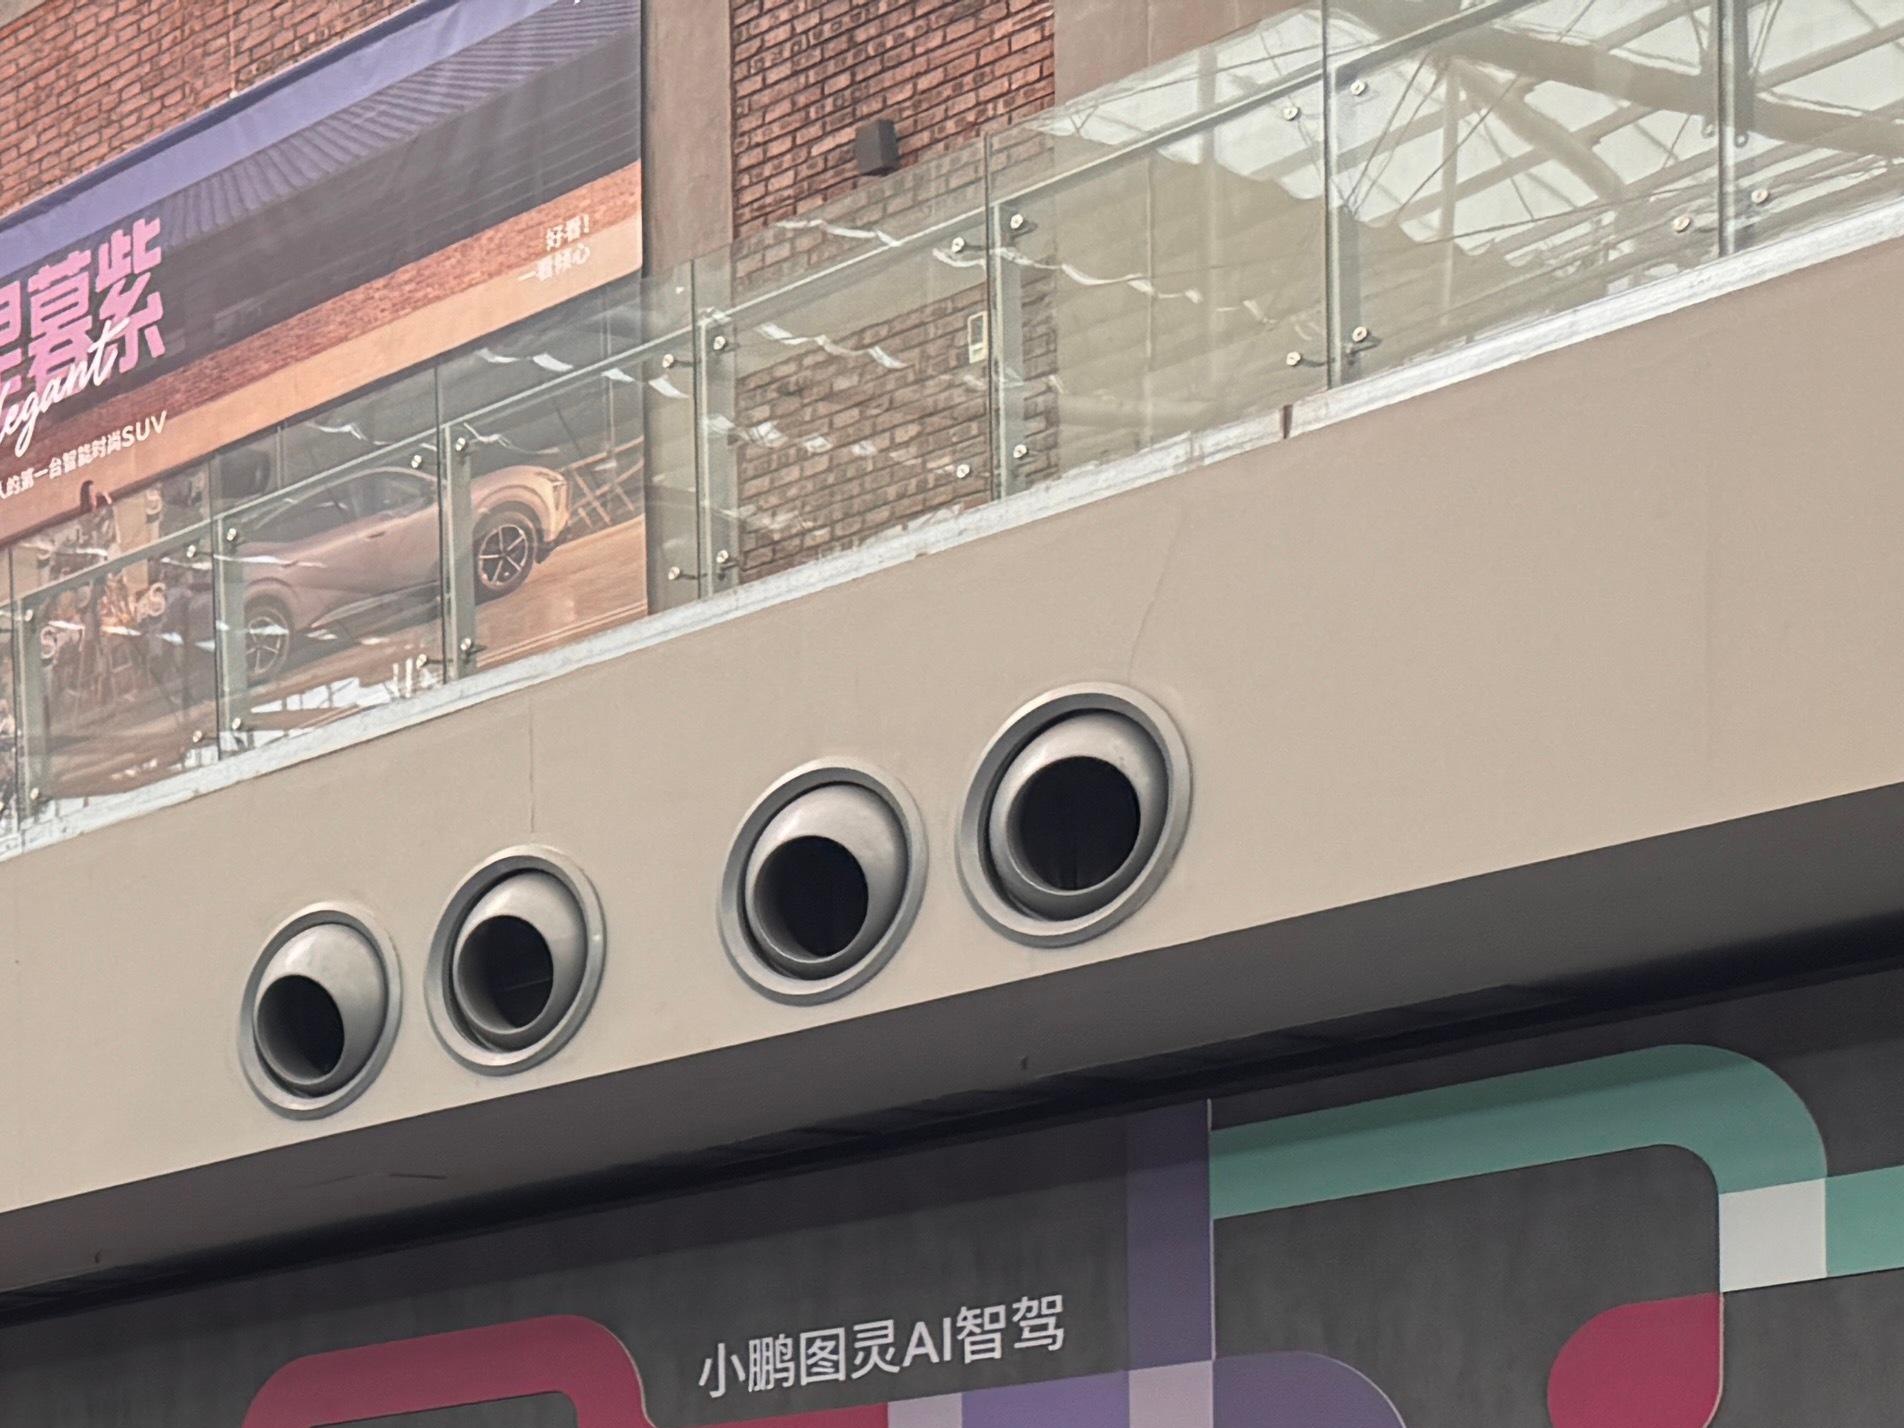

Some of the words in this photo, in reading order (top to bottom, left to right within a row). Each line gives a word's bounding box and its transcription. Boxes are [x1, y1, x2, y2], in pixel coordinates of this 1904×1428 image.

[698, 1294, 1065, 1399] 小鹏图灵AI智驾
